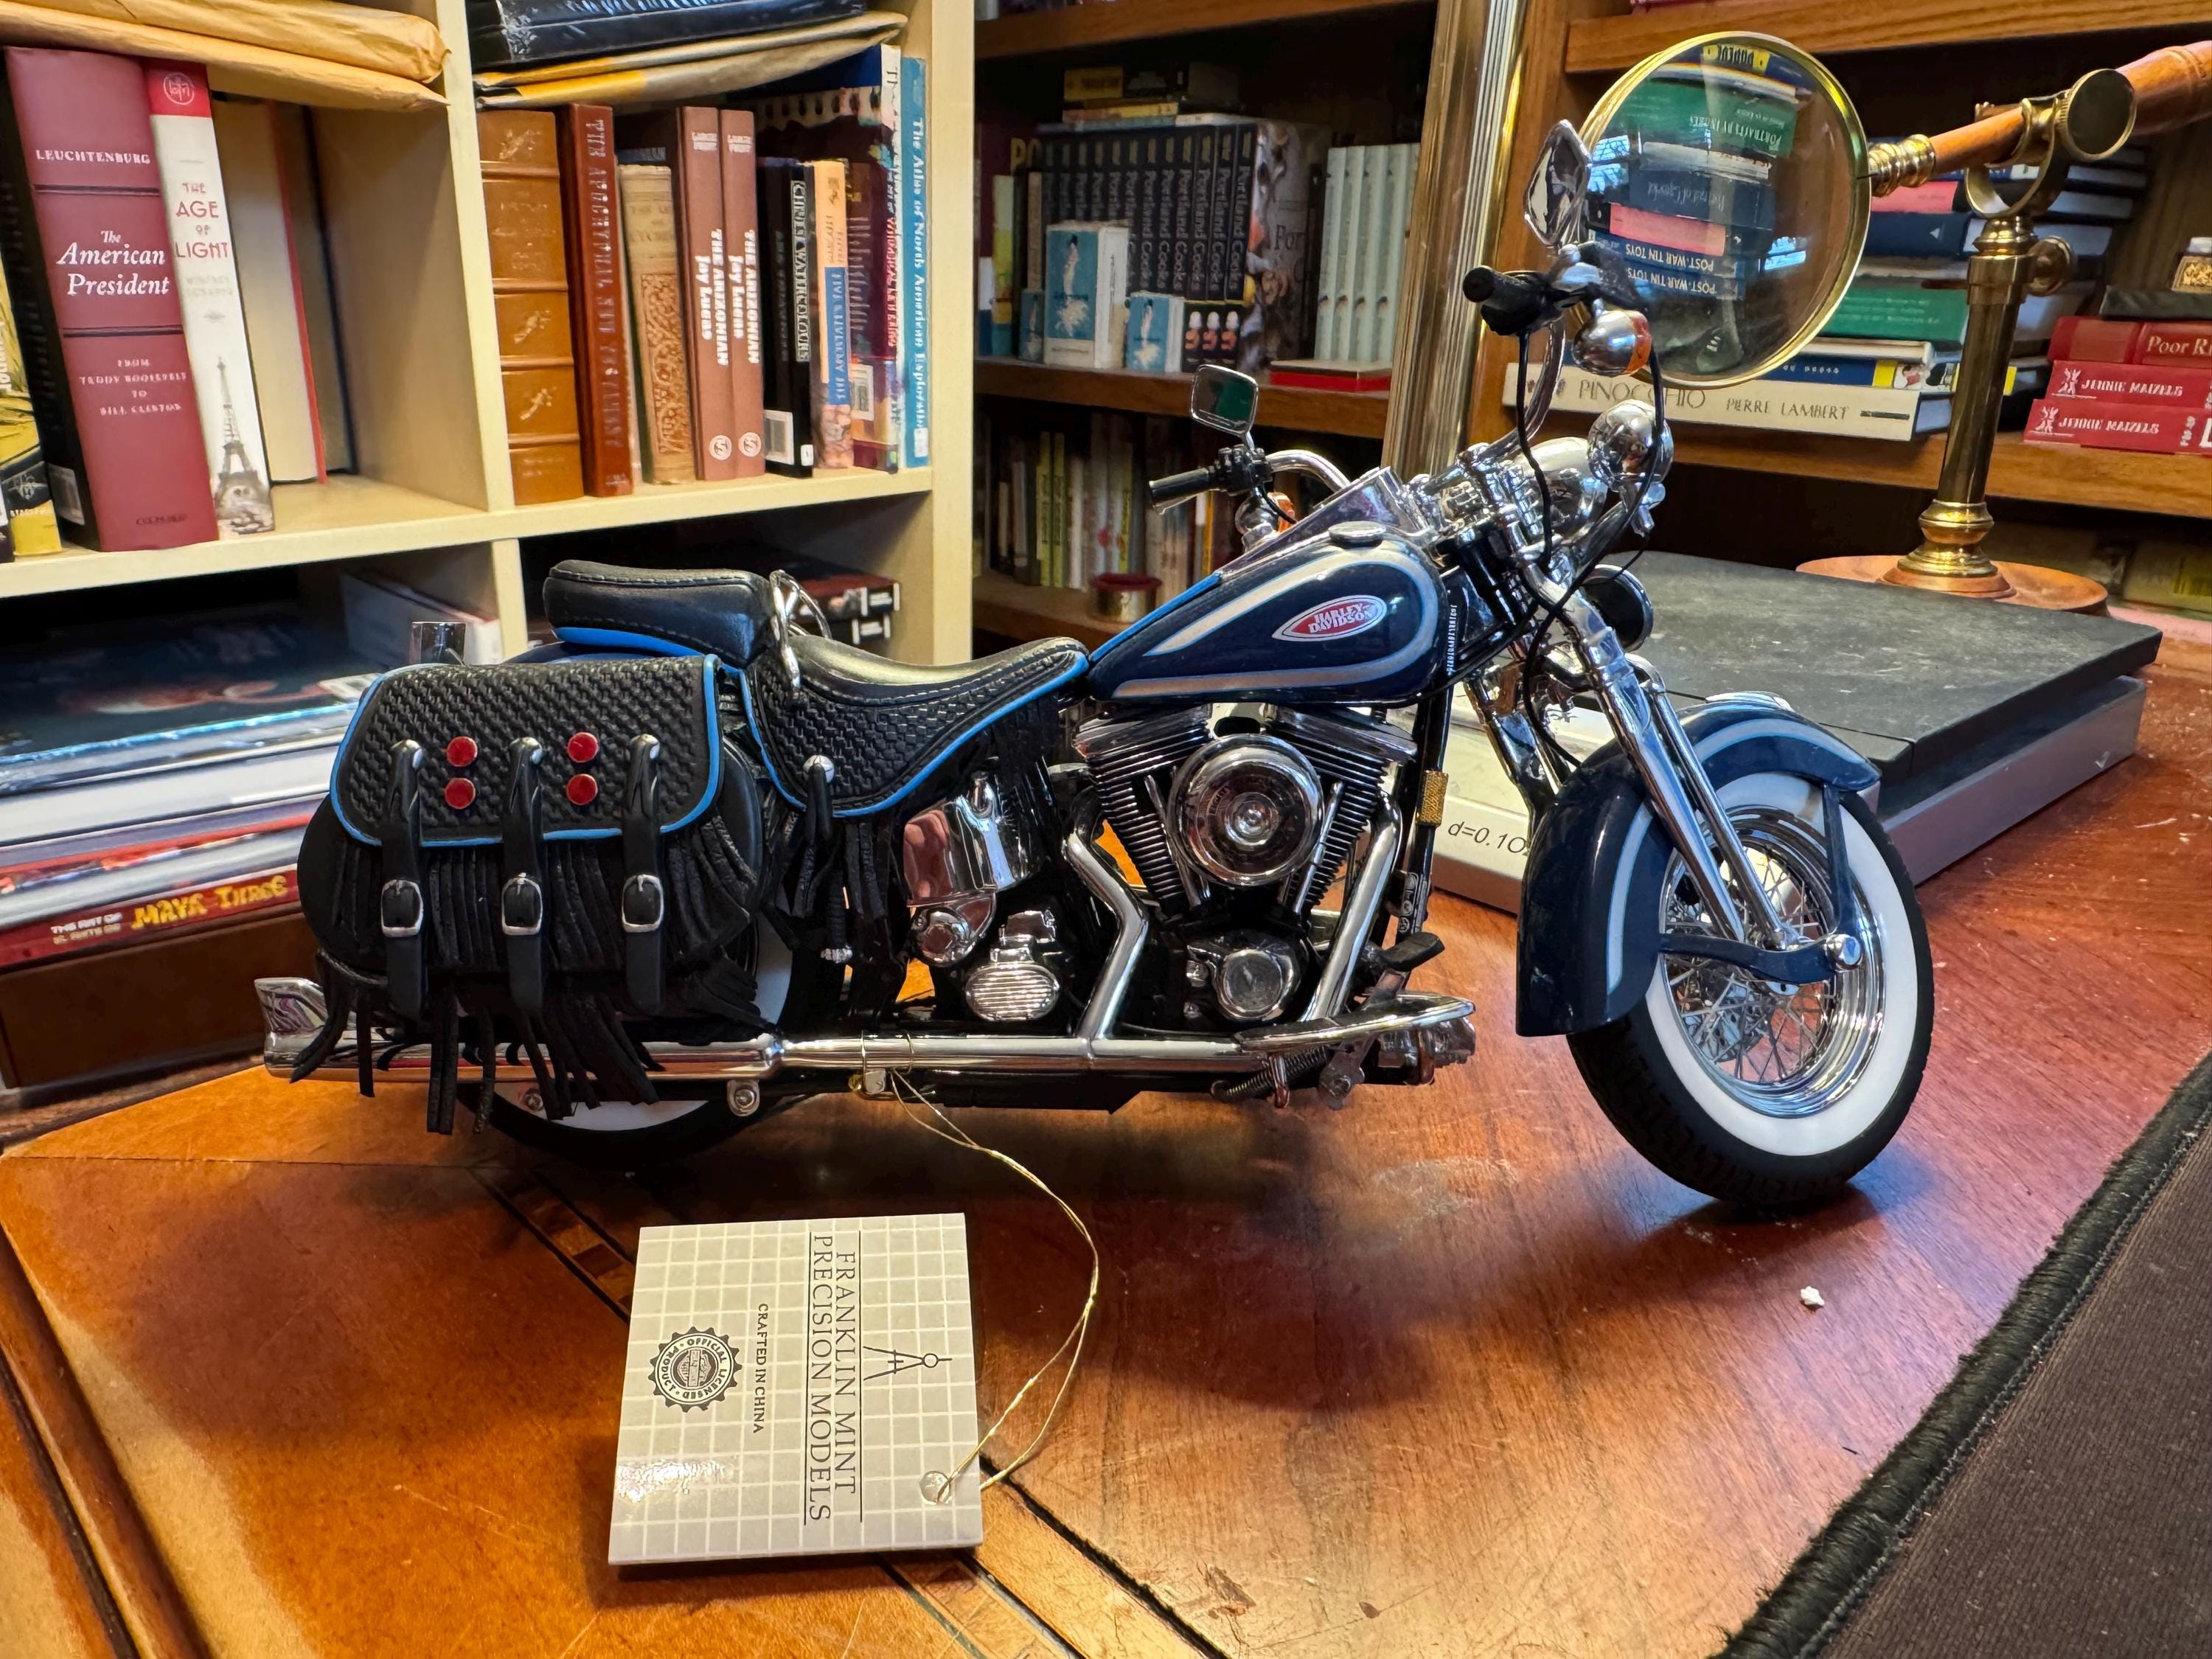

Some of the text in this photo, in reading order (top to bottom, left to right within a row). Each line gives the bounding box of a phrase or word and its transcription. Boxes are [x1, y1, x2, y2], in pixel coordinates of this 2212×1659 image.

[912, 117, 925, 151] The
[36, 150, 150, 164] LEUCHTENBURG
[182, 183, 206, 195] THE
[176, 201, 219, 218] AGE
[100, 230, 121, 243] The
[195, 224, 211, 235] OF
[56, 242, 165, 265] American
[175, 242, 229, 260] LIGHT
[711, 229, 724, 266] THE
[744, 229, 757, 266] THE
[1625, 243, 1646, 258] TOYS
[1649, 248, 1663, 262] TIN
[1627, 267, 1648, 281] TOYS
[1651, 272, 1666, 287] TIN
[68, 273, 170, 296] President
[2146, 335, 2189, 355] Poor
[2081, 379, 2126, 392] JENNIE
[1781, 400, 1849, 420] LAMBERT
[1308, 605, 1377, 633] DAVIDSON
[661, 1346, 680, 1392] PRODUCT
[682, 1338, 728, 1399] OFFICIAL LICENSED
[753, 1303, 769, 1434] CRAFTED IN CHINA
[809, 1235, 833, 1520] PRECISION MODELS
[834, 1252, 857, 1495] FRANKLIN MINT
